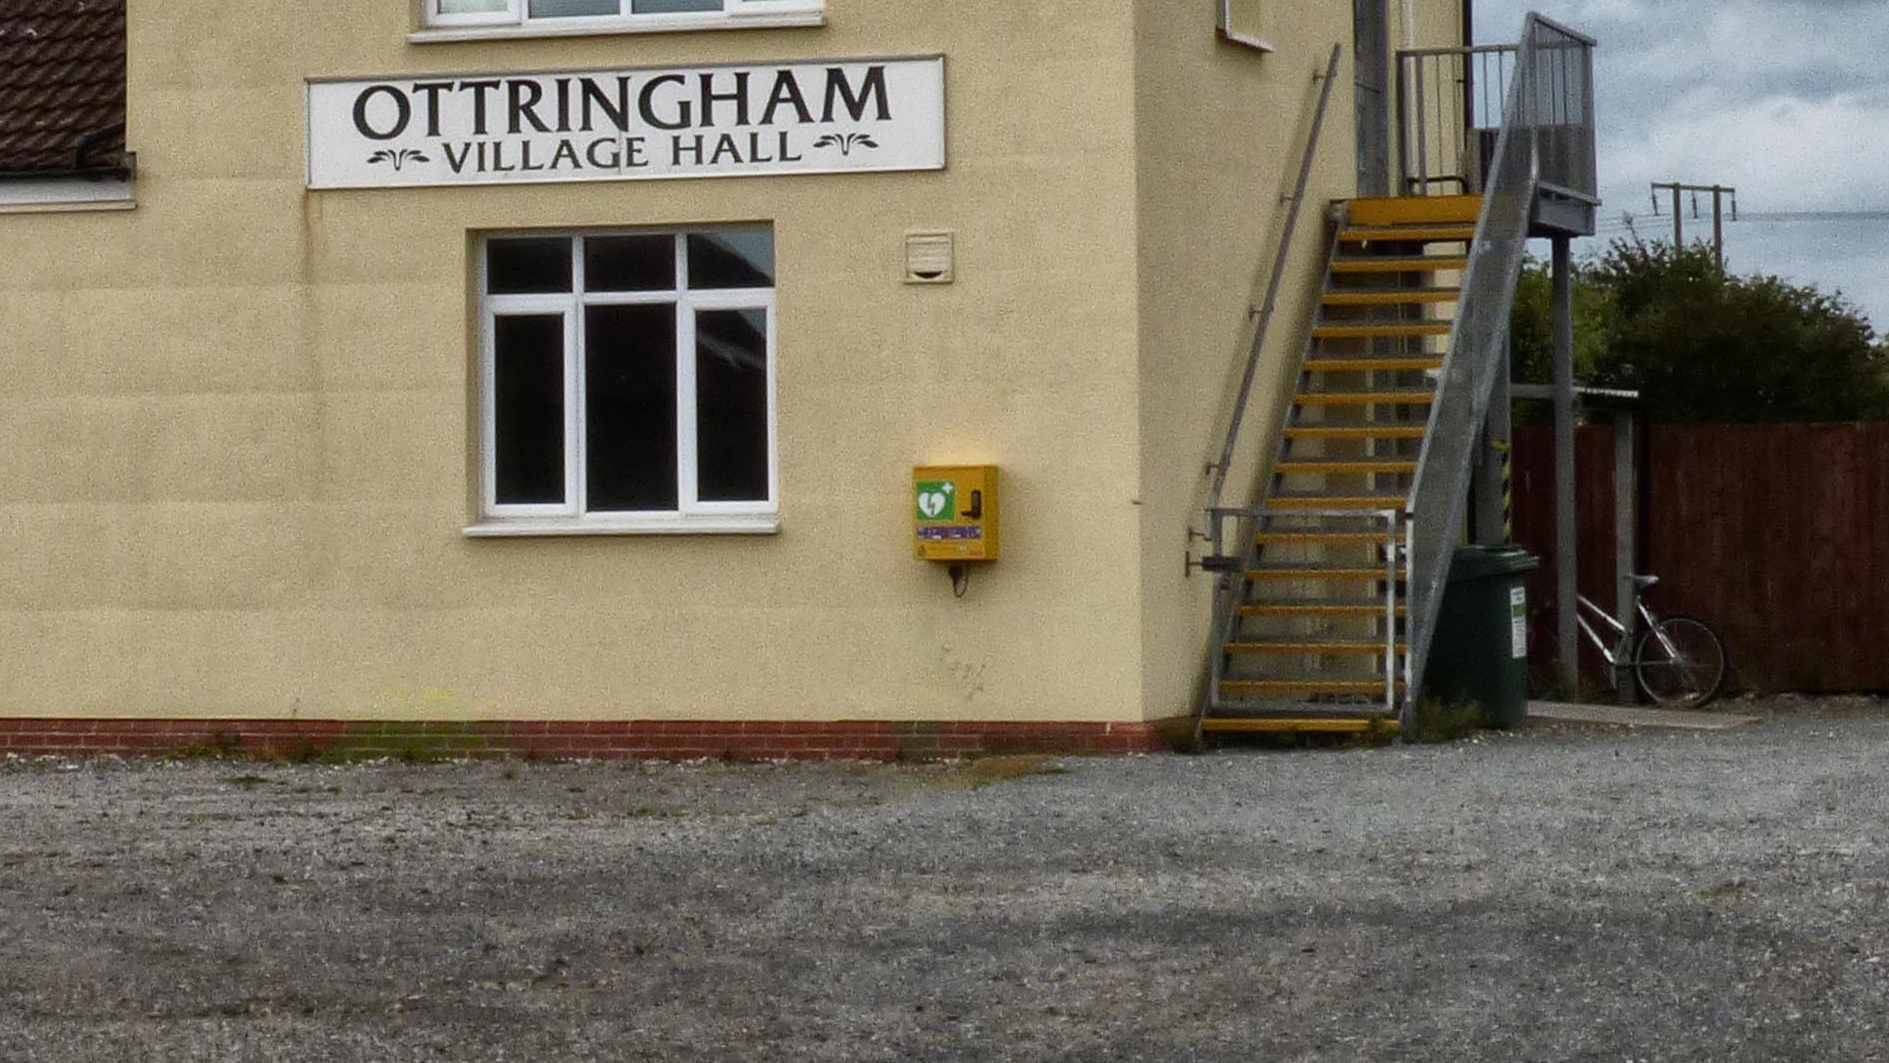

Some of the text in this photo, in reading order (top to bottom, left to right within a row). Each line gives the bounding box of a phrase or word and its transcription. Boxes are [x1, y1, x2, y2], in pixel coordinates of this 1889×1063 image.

[352, 65, 892, 141] OTTRINGHAM
[441, 131, 802, 174] VILLAGE HALL
